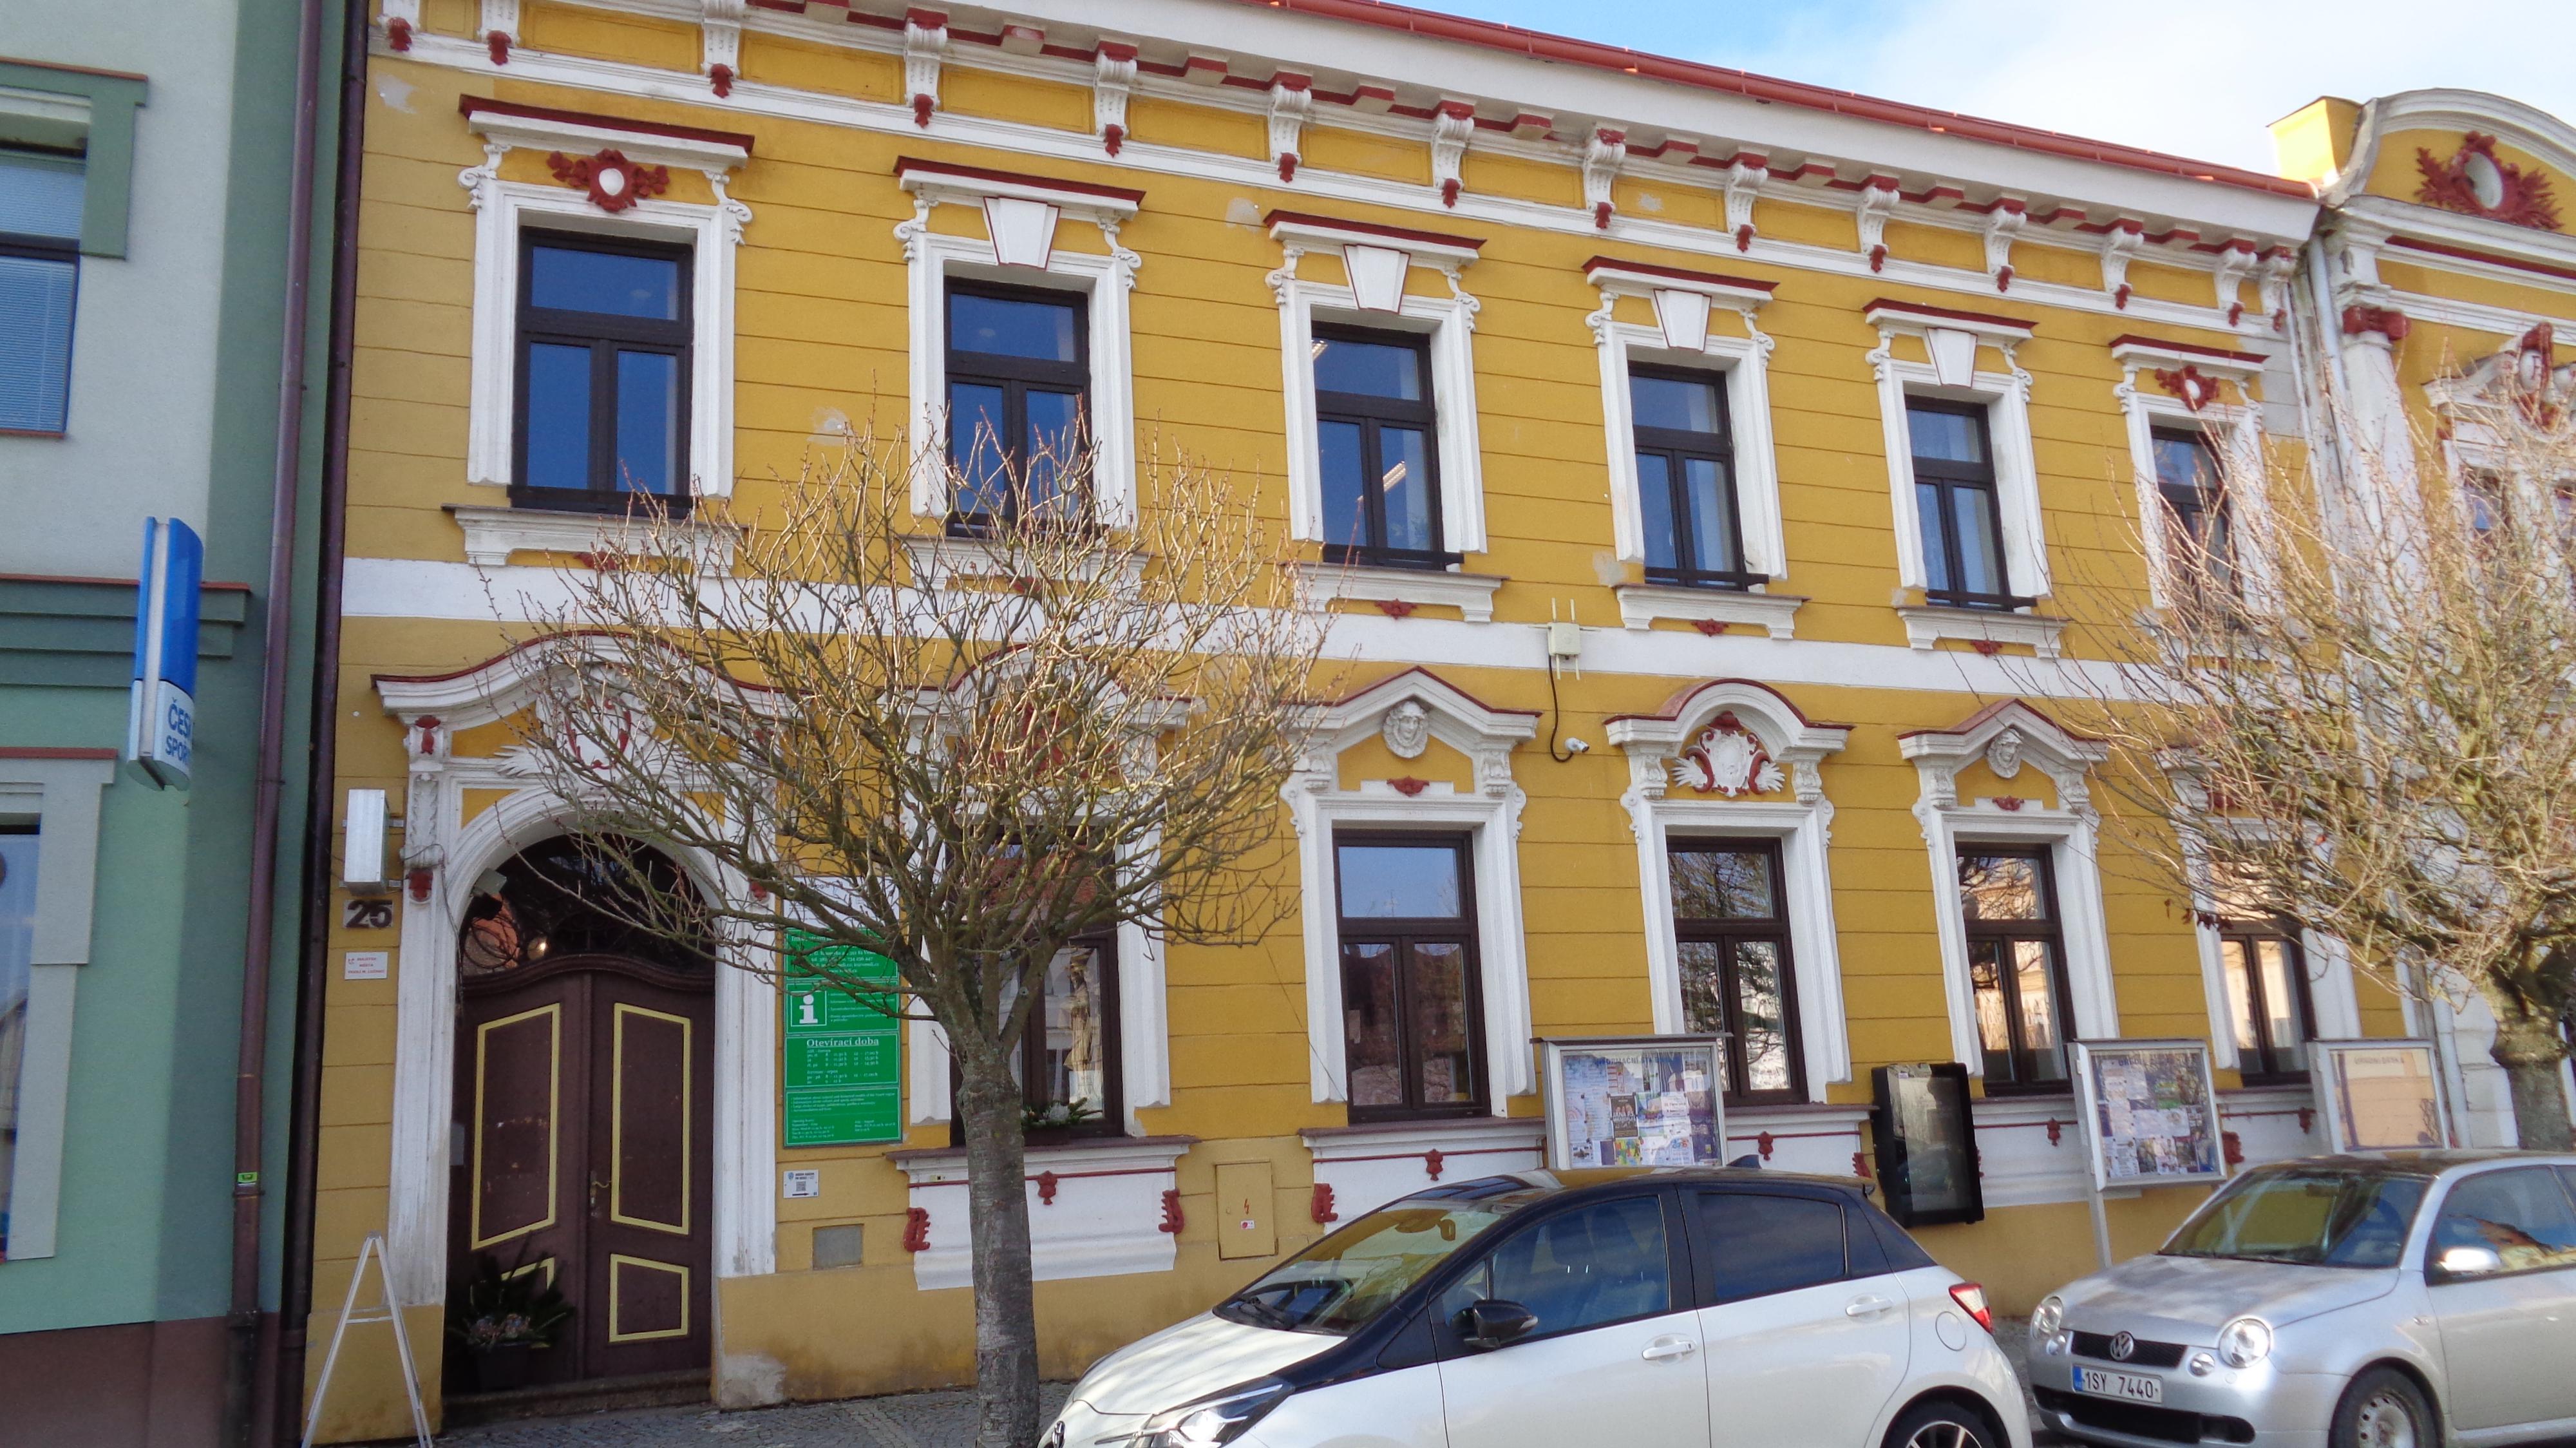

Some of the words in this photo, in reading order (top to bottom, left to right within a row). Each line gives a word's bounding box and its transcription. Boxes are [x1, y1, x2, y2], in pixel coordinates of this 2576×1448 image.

[346, 900, 393, 928] 25
[806, 1038, 853, 1047] Otevírací
[855, 1037, 879, 1045] doba
[2085, 1371, 2107, 1392] 1SY
[2118, 1376, 2154, 1398] 7440
